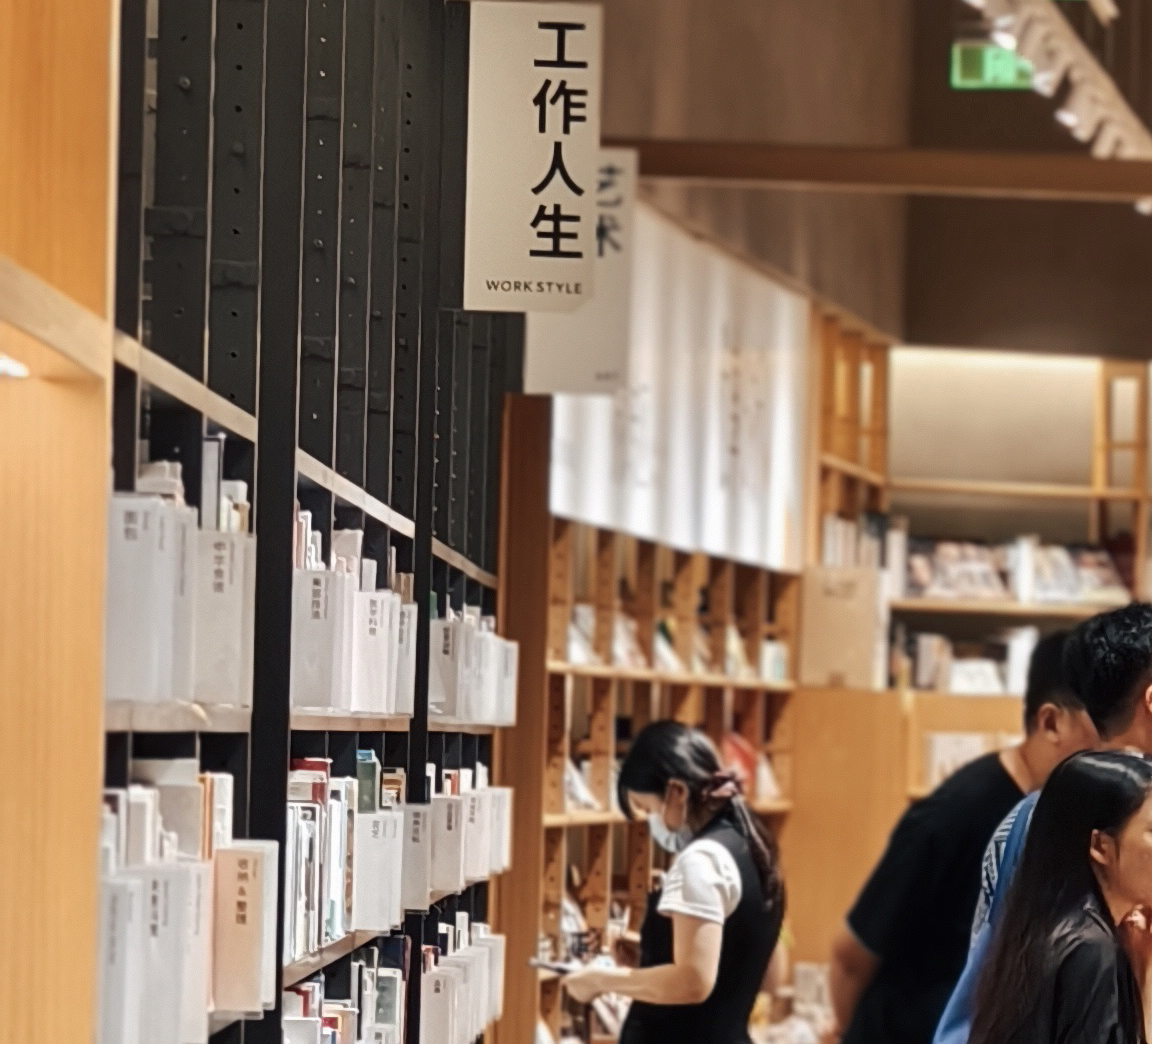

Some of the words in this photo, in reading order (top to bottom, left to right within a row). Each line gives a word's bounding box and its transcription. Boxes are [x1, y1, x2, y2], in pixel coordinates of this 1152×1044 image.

[529, 21, 588, 258] 工作人生
[485, 279, 533, 293] WORK
[536, 281, 582, 294] STYLE
